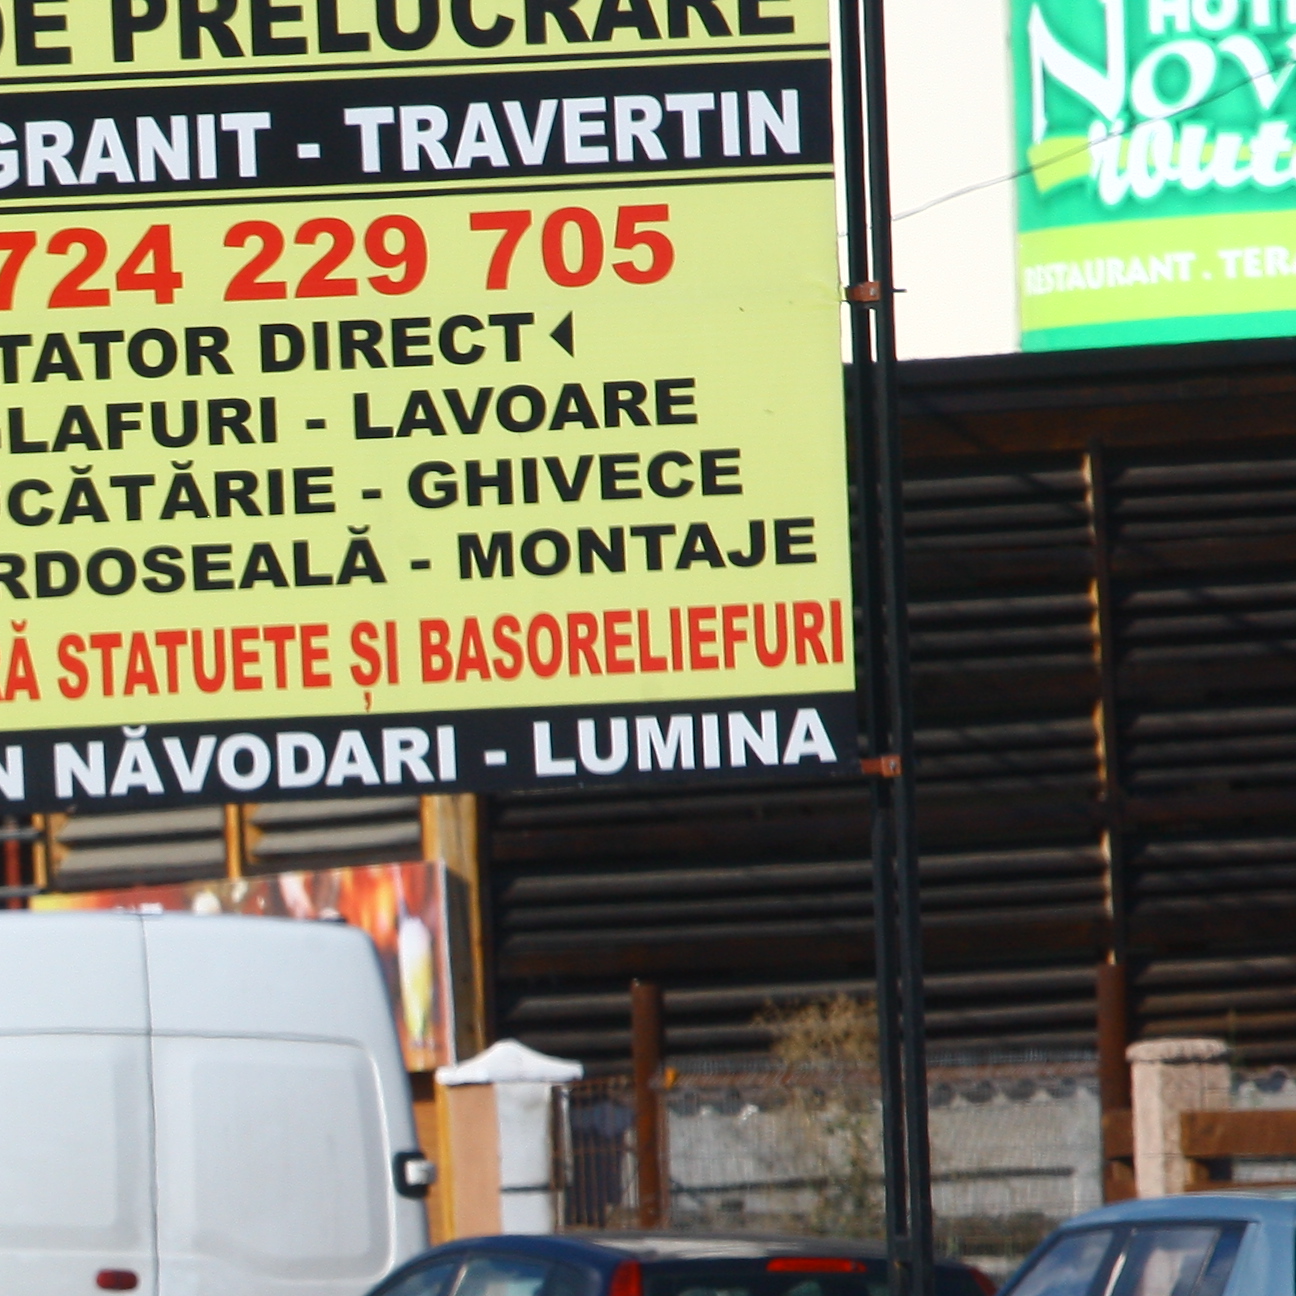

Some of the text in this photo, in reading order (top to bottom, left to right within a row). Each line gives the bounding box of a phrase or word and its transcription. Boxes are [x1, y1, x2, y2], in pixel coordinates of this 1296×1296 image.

[298, 144, 320, 158] -
[344, 89, 800, 172] TRAVERTIN
[225, 215, 427, 301] 229
[471, 204, 674, 289] 705
[1024, 252, 1196, 296] RESTAURANT
[1217, 246, 1296, 279] TER
[260, 313, 533, 372] DIRECT
[307, 419, 325, 429] -
[354, 378, 697, 439] LAVOARE
[363, 489, 381, 499] -
[408, 449, 742, 508] GHIVECE
[411, 561, 430, 569] -
[458, 519, 816, 579] MONTAJE
[59, 624, 331, 699] STATUETE
[352, 622, 398, 702] ȘI
[421, 600, 843, 682] BASORELIEFURI
[54, 725, 456, 797] NĂVODARI
[485, 751, 506, 764] -
[534, 709, 836, 775] LUMINA
